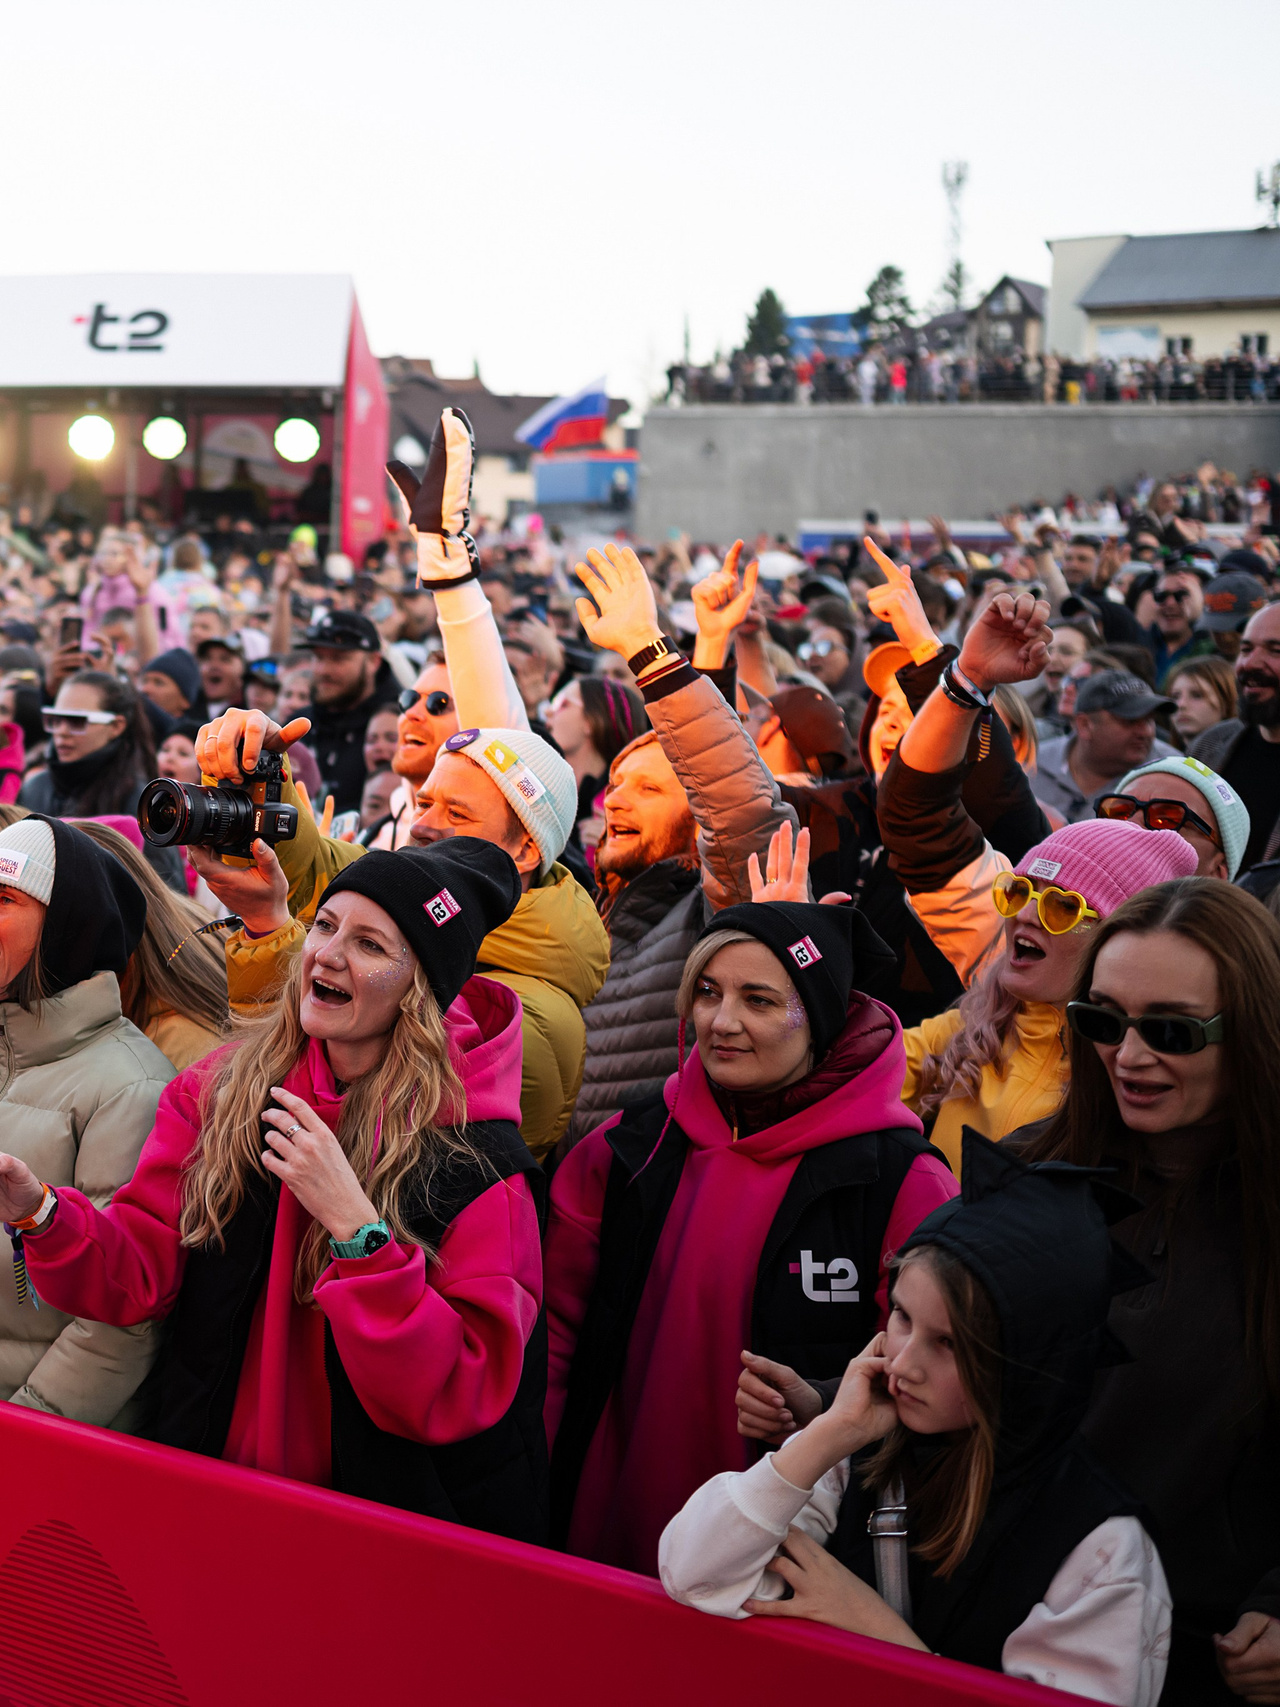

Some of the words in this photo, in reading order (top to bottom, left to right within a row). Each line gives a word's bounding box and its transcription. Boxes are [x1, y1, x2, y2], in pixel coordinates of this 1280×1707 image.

[73, 303, 168, 351] t2
[516, 781, 534, 799] GUEST
[521, 777, 537, 796] SPECIAL
[0, 857, 19, 867] SPECIAL
[431, 901, 446, 922] t2
[795, 946, 809, 965] t2
[789, 1250, 859, 1302] t2
